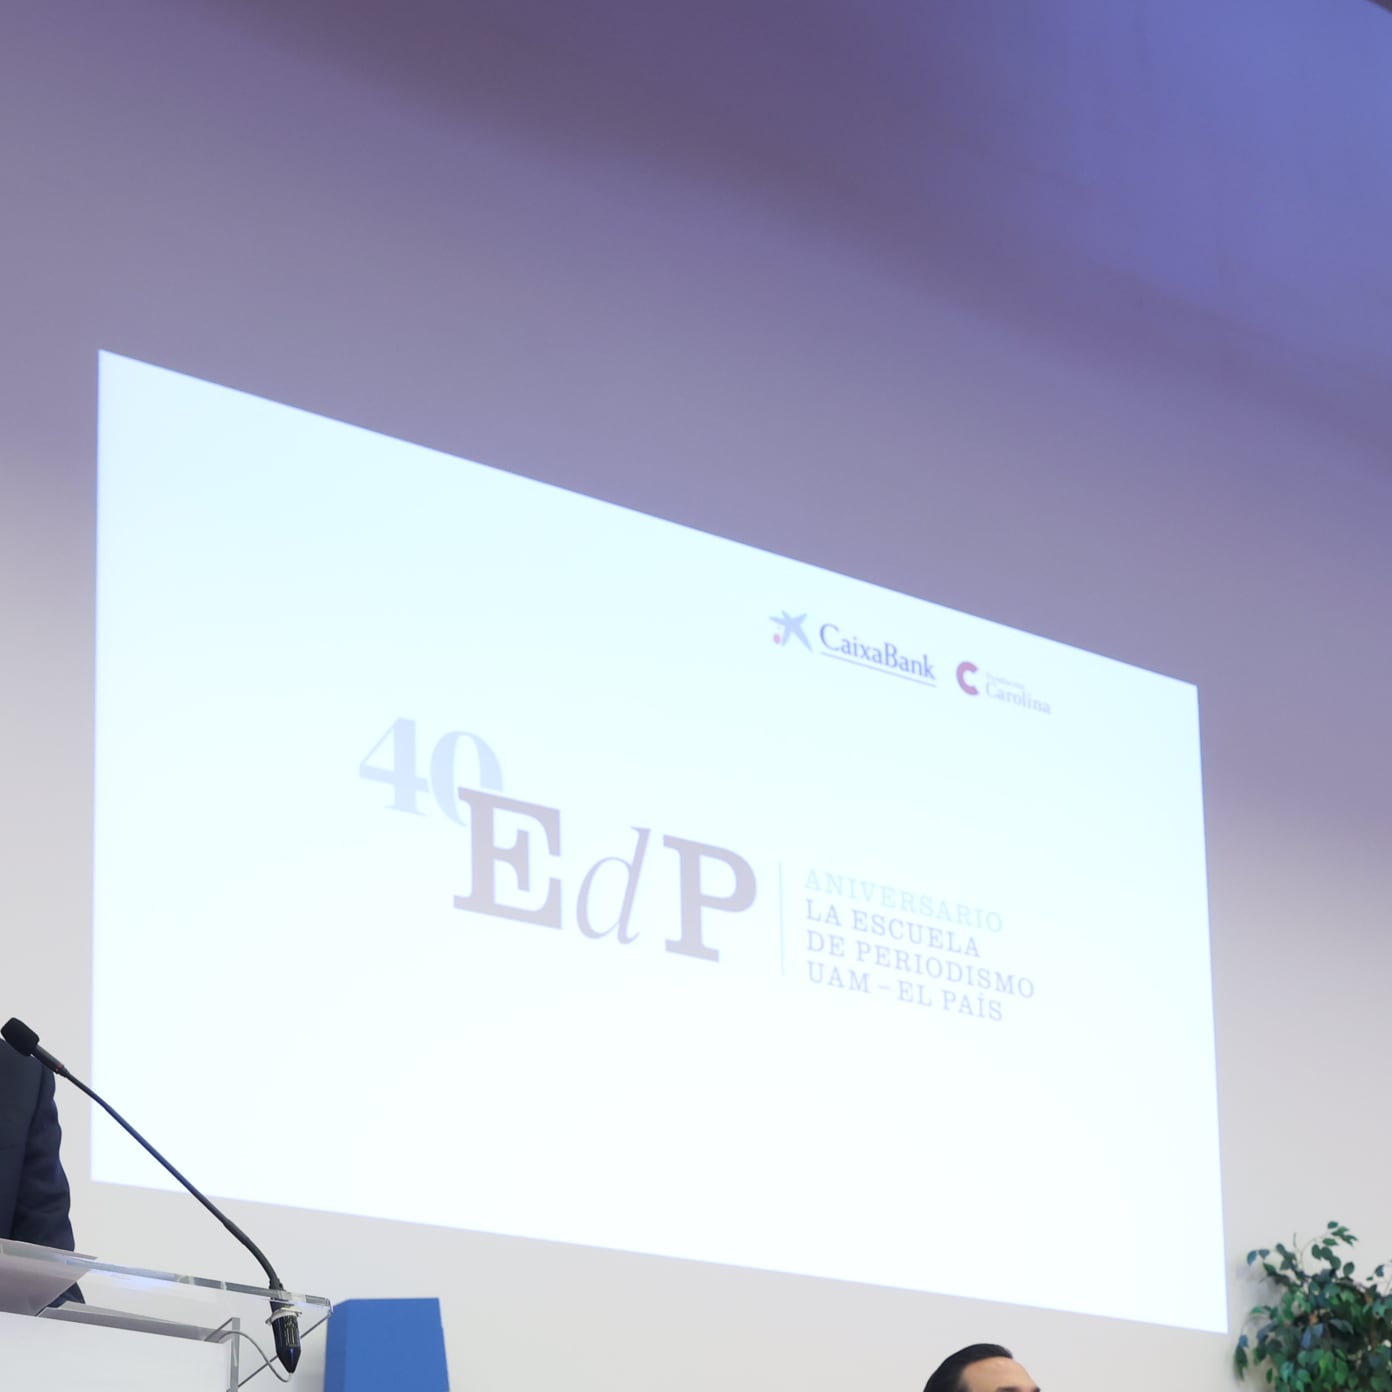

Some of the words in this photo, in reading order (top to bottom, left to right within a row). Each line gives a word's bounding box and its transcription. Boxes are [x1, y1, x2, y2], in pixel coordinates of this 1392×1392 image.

[819, 622, 936, 681] CaixaBank
[985, 681, 1051, 715] Carolina
[358, 715, 504, 828] 40
[451, 785, 758, 963] EdP
[804, 867, 1005, 935] ANIVERSARIO
[805, 898, 844, 929] LA
[852, 908, 982, 959] ESCUELA
[806, 929, 846, 958] DE
[856, 940, 1036, 1002] PERIODISMO
[807, 960, 871, 994] UAM
[897, 980, 933, 1008] EL
[941, 987, 1004, 1023] PAÍS
